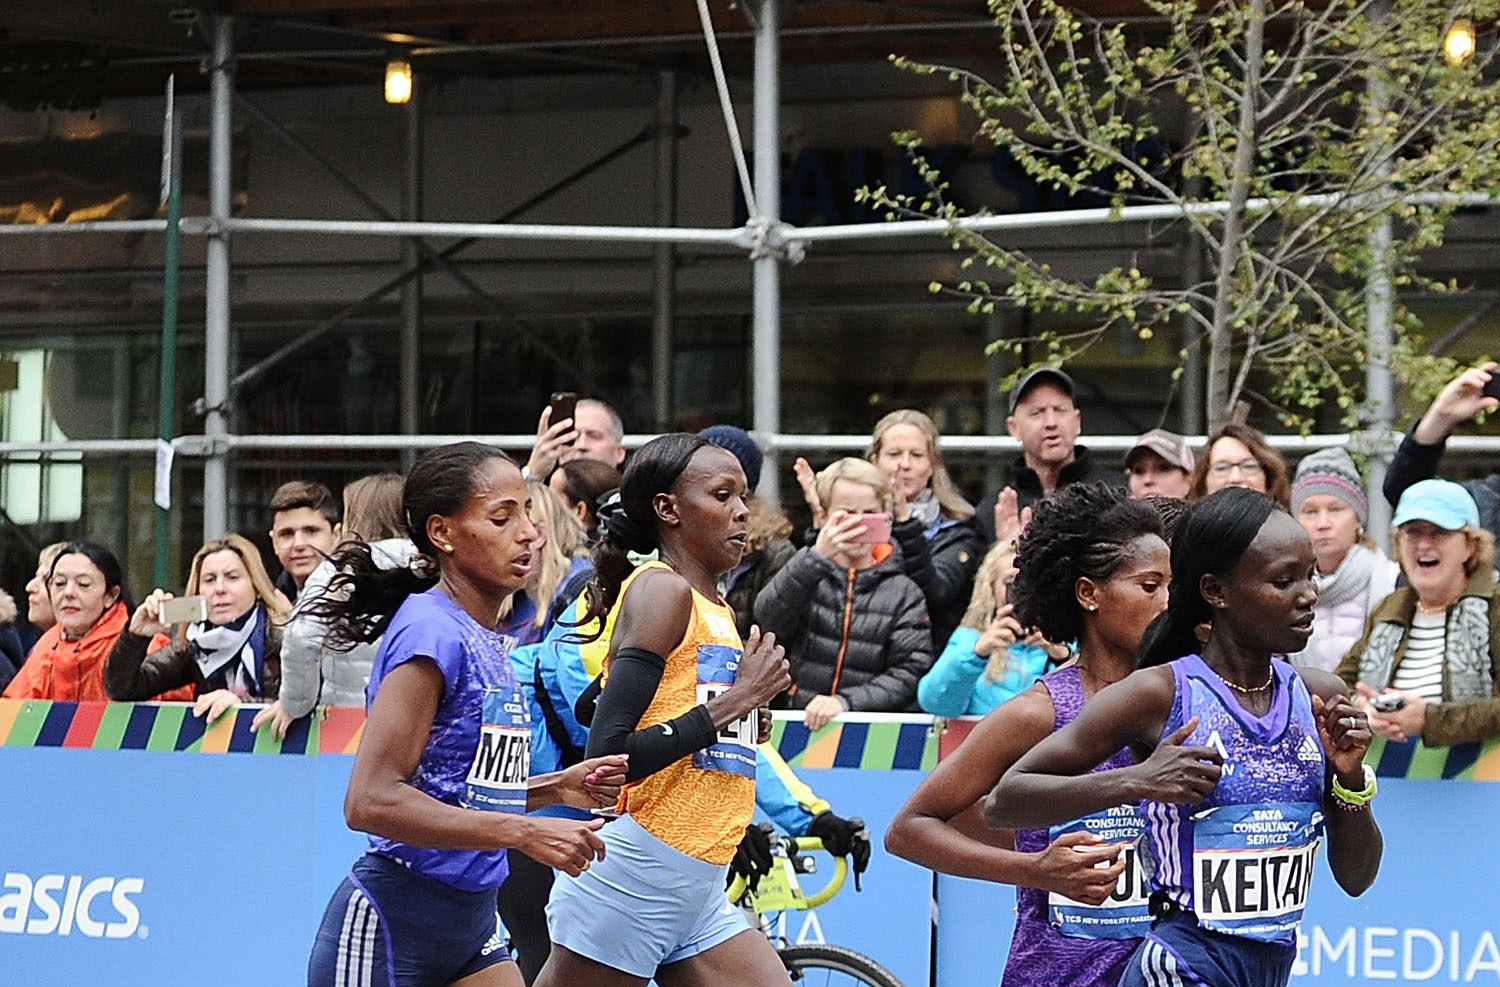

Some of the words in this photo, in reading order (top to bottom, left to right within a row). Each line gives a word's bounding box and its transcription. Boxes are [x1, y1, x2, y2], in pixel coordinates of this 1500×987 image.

[1107, 806, 1134, 817] TATA
[1253, 809, 1283, 820] TATA
[1232, 821, 1299, 833] CONSULTANCY
[1099, 827, 1139, 840] SERVICES
[1246, 833, 1288, 845] SERVICES
[1065, 915, 1081, 923] TCS
[1083, 917, 1099, 925] NEW
